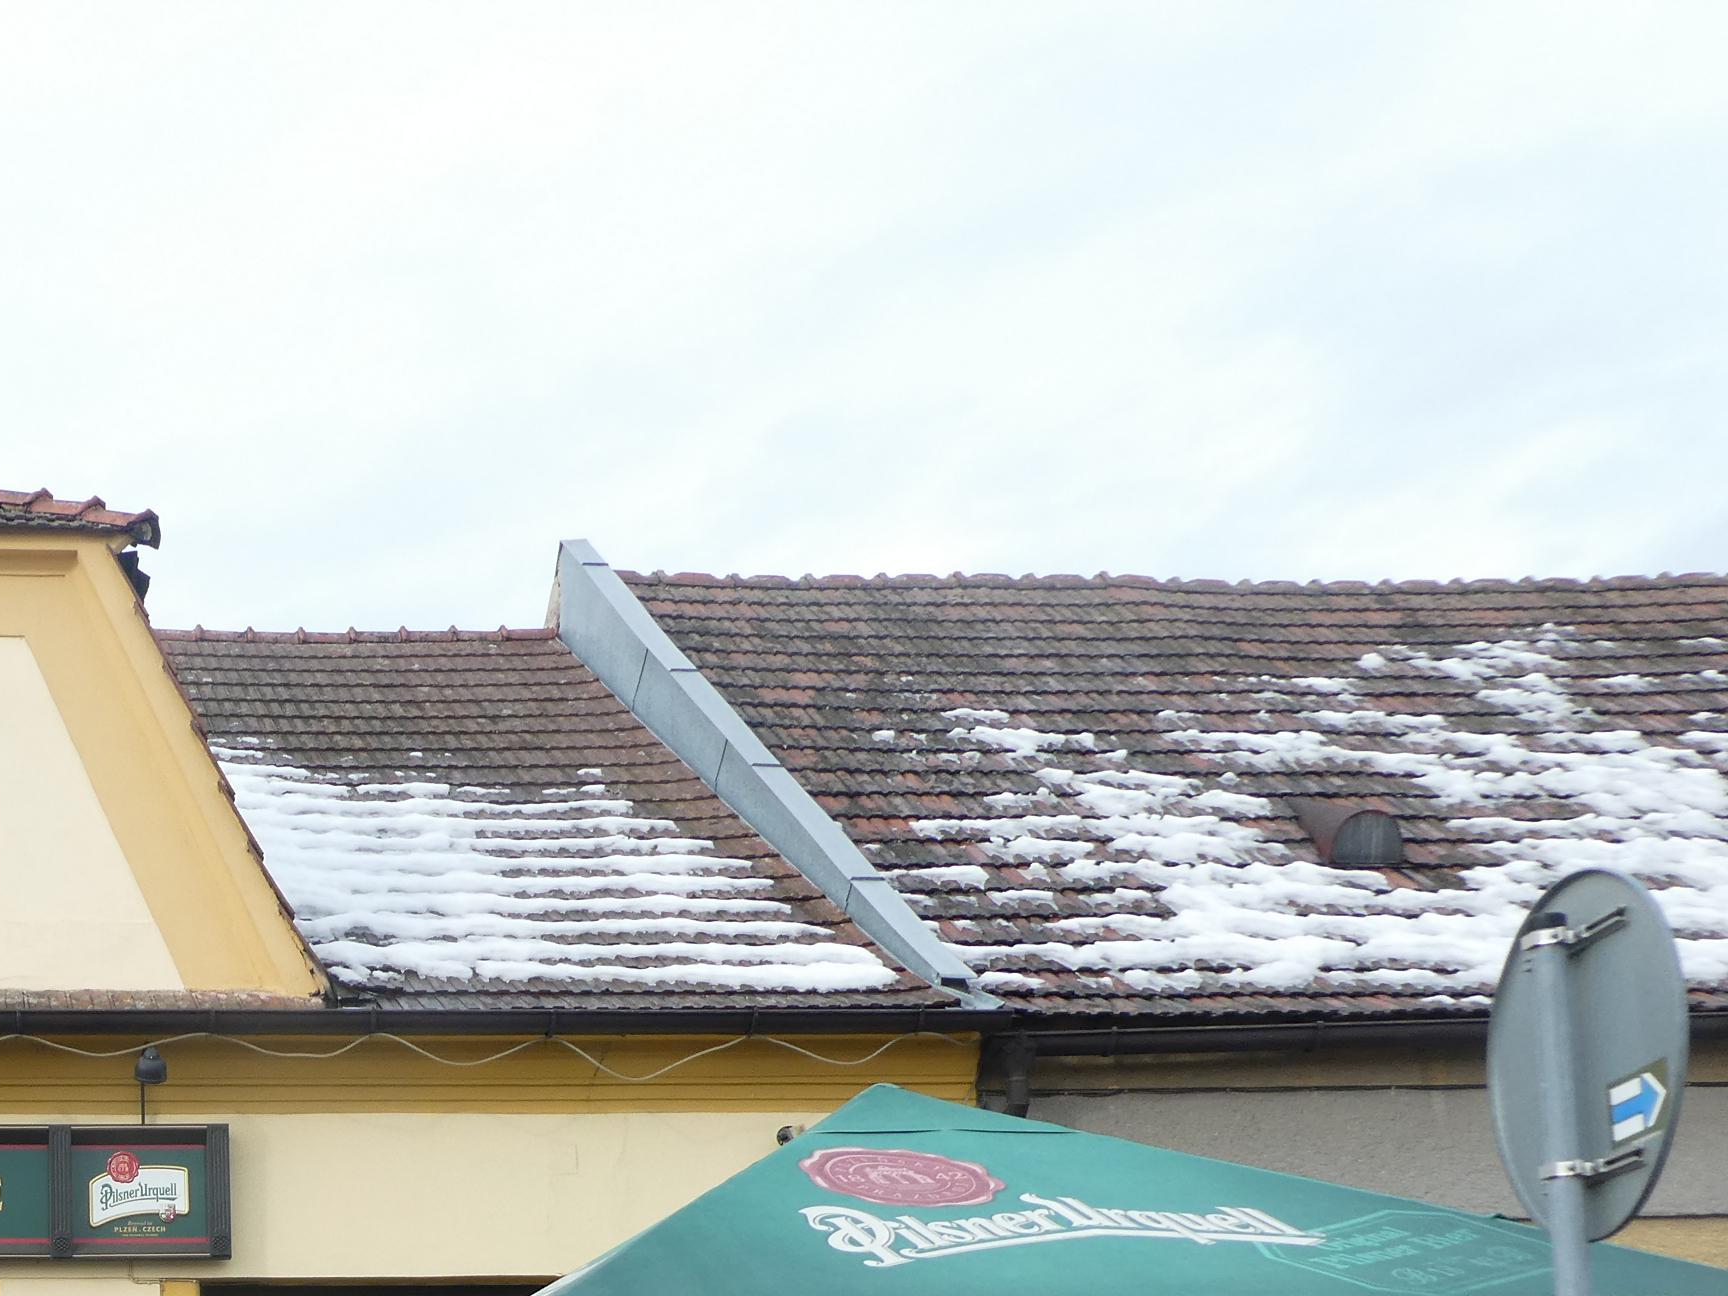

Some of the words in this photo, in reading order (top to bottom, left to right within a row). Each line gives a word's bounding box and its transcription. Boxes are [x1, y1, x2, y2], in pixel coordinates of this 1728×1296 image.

[99, 1183, 140, 1211] Pilsner
[139, 1181, 177, 1202] Urquell
[797, 1204, 1060, 1268] Pilsner
[1018, 1192, 1317, 1246] Urquell
